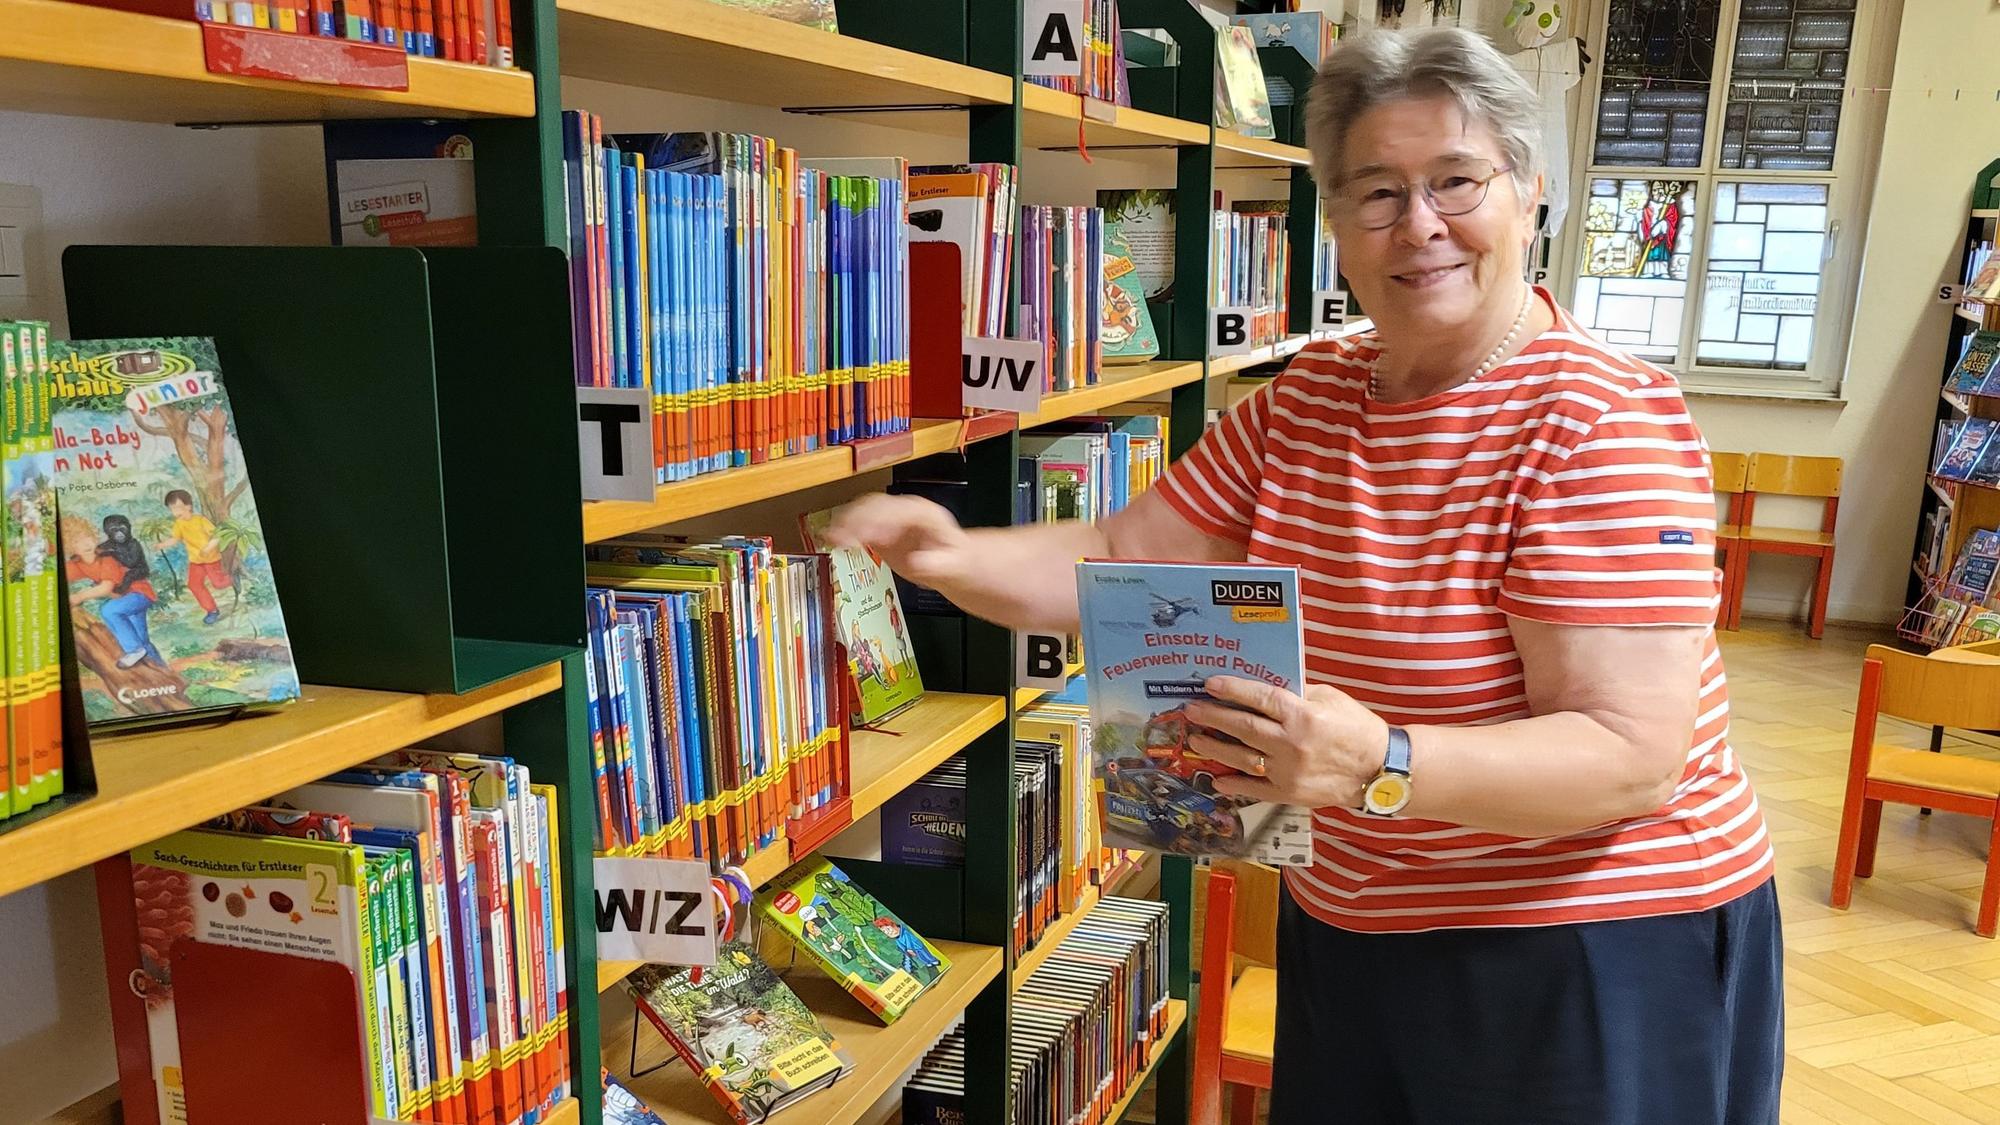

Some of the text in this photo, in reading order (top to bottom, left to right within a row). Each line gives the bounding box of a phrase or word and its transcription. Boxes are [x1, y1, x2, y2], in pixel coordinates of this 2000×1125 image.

[1031, 13, 1078, 61] A
[347, 191, 424, 213] LESESTARTER
[920, 187, 949, 197] Erstleser
[1535, 271, 1546, 284] P
[1940, 286, 1952, 299] S
[1322, 299, 1344, 324] E
[1217, 314, 1246, 346] B
[962, 354, 1035, 392] U/V
[580, 403, 640, 476] T
[78, 450, 117, 471] Not
[69, 482, 92, 493] Pope
[95, 480, 137, 490] Osborne
[1214, 583, 1280, 601] DUDEN
[1238, 608, 1281, 619] Leseprofi
[1144, 632, 1241, 652] Einsatz bei
[1026, 635, 1063, 679] B
[1102, 651, 1291, 690] Feuerwehr und Polizei
[925, 822, 966, 838] HELDEN
[153, 849, 304, 873] Sach-Geschichten für Erstleser
[405, 877, 415, 925] Bücherbär
[594, 888, 706, 936] W/Z
[225, 922, 239, 932] und
[264, 928, 288, 938] trauen
[308, 934, 332, 945] Augen
[372, 899, 383, 948] Bücherbär
[228, 933, 240, 943] Sie
[240, 936, 263, 946] sehen
[264, 938, 283, 949] einen
[284, 941, 320, 954] Menschen
[321, 947, 336, 956] von
[662, 973, 684, 987] WAS
[670, 985, 688, 997] DIE
[706, 983, 720, 996] im
[718, 968, 751, 989] Wald?
[777, 1060, 793, 1071] Bitte
[792, 1052, 807, 1064] nicht
[812, 1045, 824, 1054] das
[785, 1053, 831, 1078] Buch schreiben
